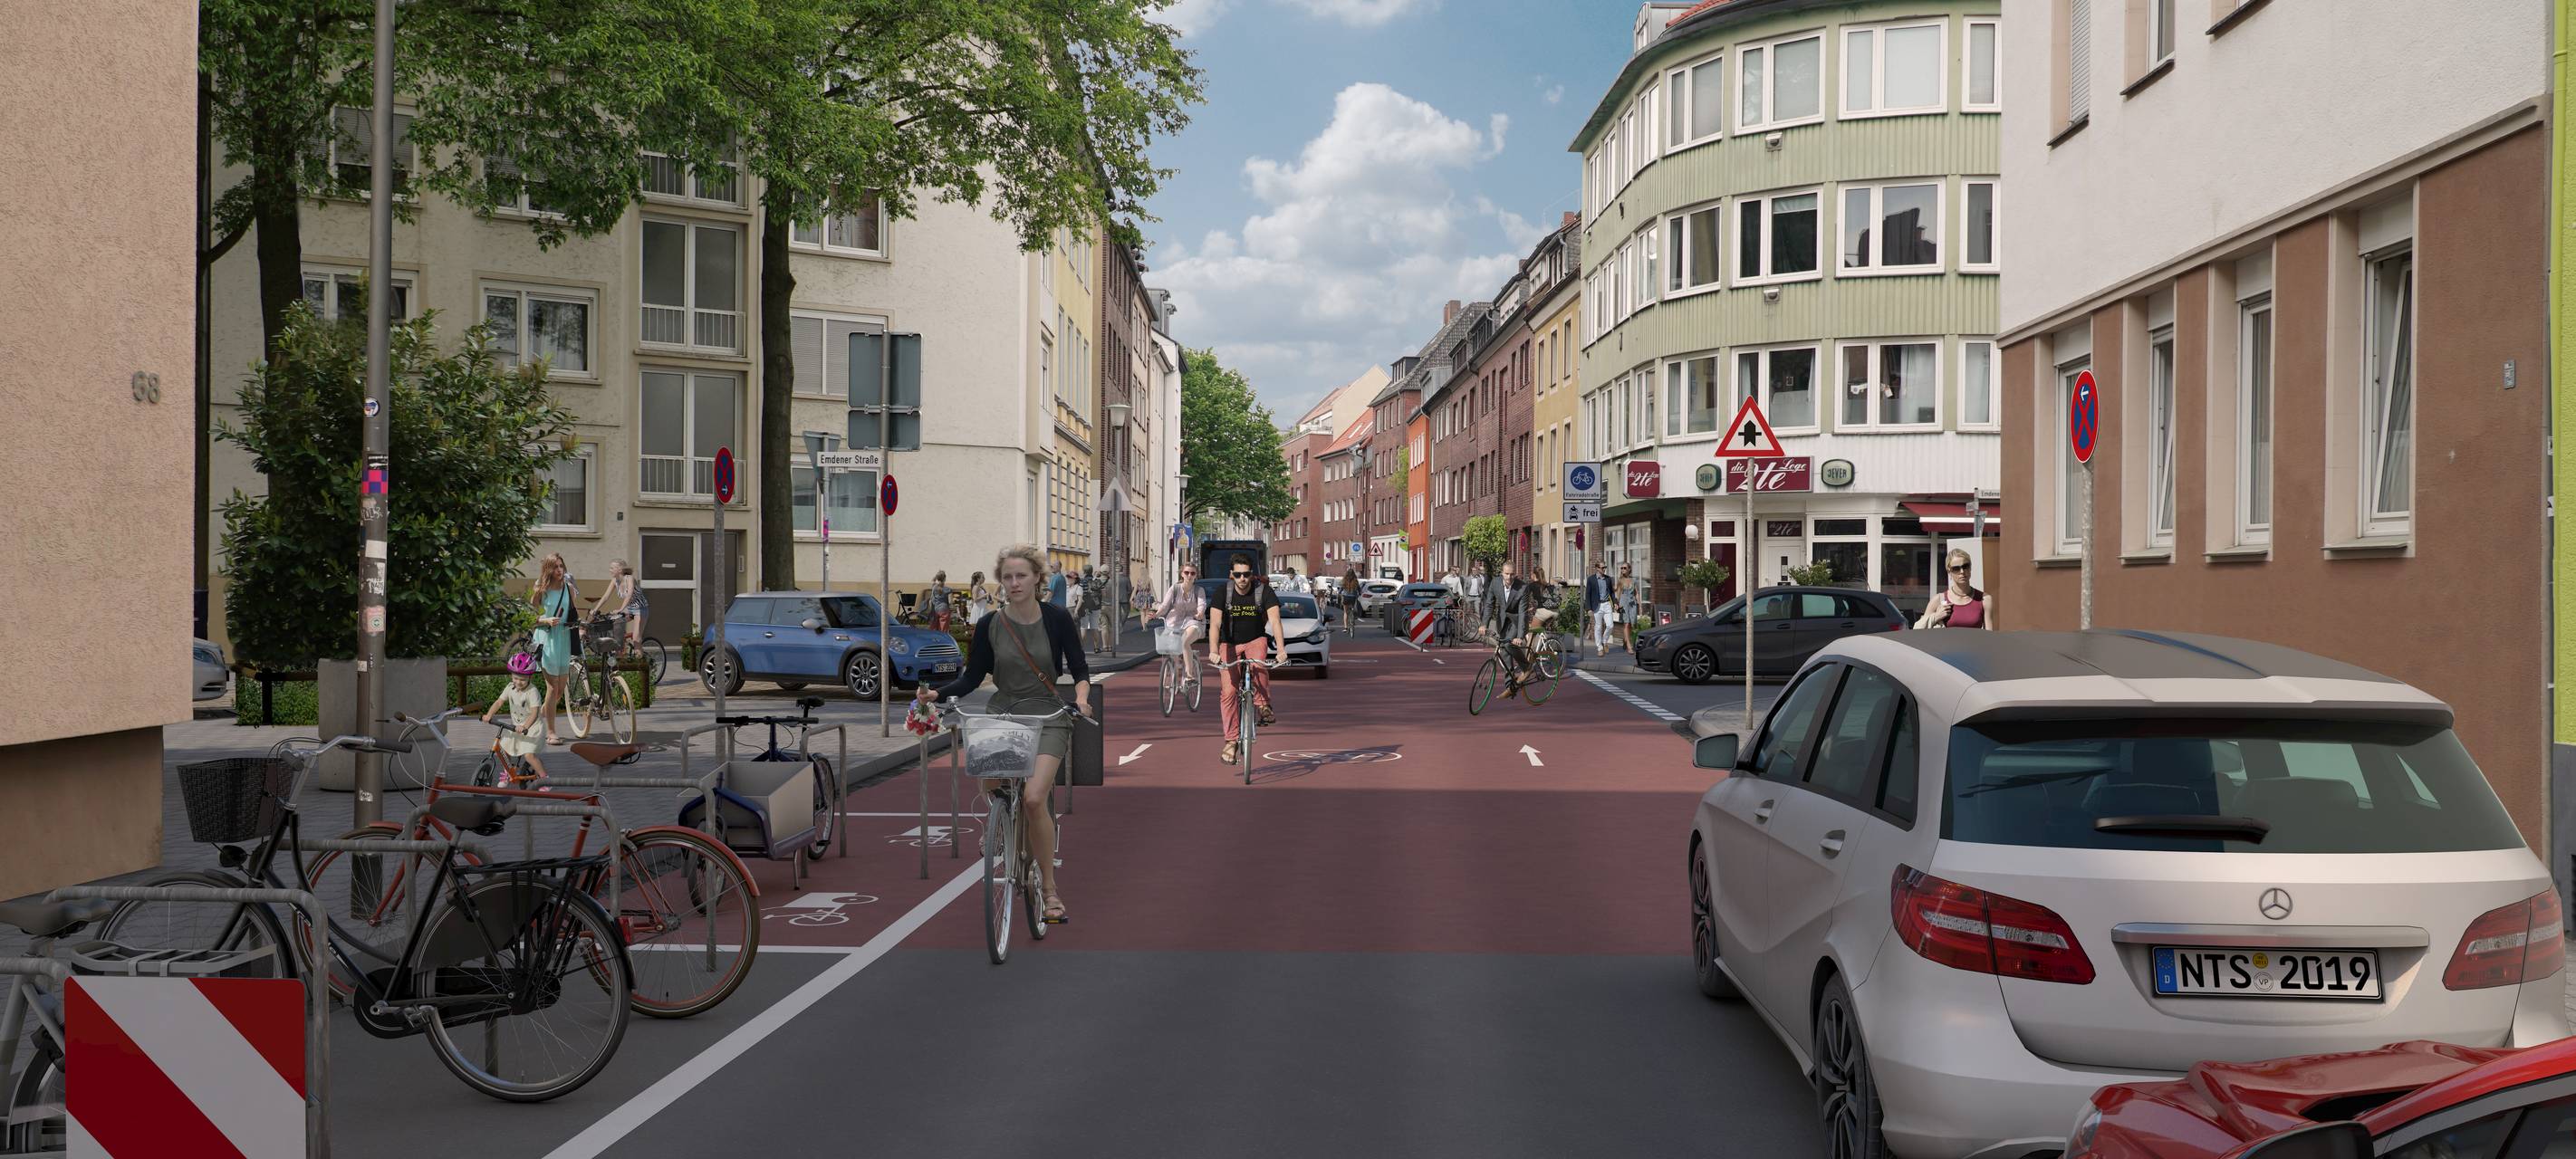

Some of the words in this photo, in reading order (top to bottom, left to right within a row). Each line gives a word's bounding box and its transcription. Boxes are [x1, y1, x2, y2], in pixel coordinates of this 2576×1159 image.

[131, 370, 159, 404] 68
[821, 455, 851, 465] Emdener
[855, 455, 879, 465] Straße
[1731, 461, 1744, 472] die
[1779, 459, 1807, 475] Loge
[1827, 467, 1847, 479] JEVER
[1630, 472, 1653, 487] 2te
[1582, 508, 1599, 517] frei
[2180, 953, 2252, 989] NTS
[2279, 955, 2370, 991] 2019
[2164, 974, 2171, 984] D
